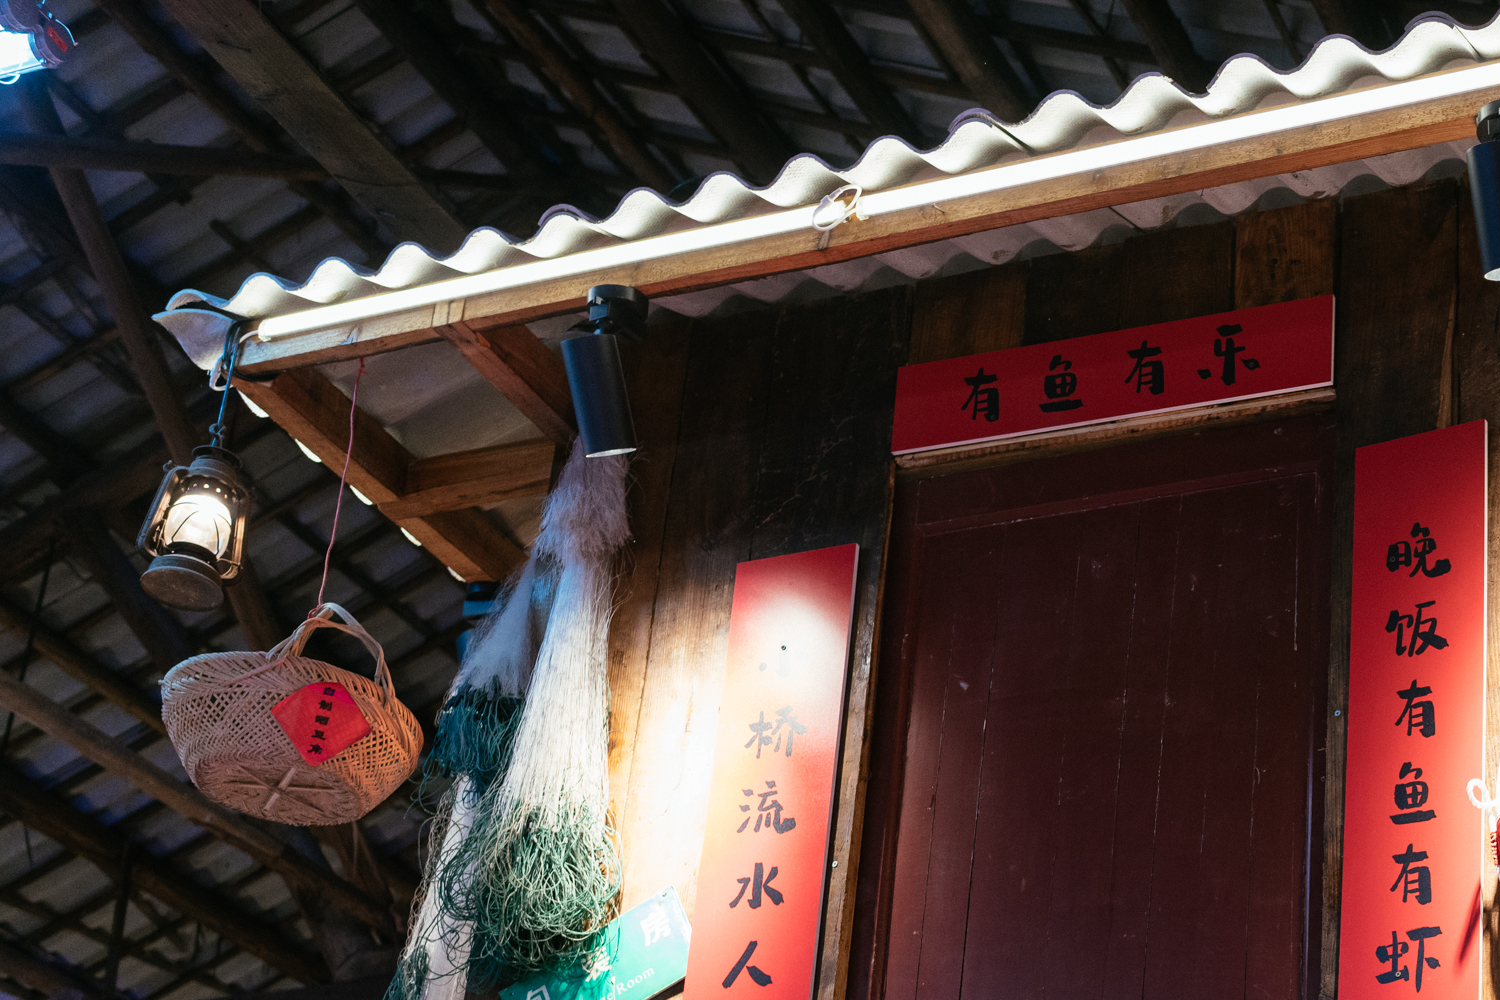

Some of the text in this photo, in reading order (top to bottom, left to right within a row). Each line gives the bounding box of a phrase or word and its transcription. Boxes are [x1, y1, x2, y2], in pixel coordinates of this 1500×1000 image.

[959, 324, 1261, 422] 有鱼有乐
[1375, 522, 1451, 992] 晚饭有鱼有虾
[615, 967, 655, 996] Room
